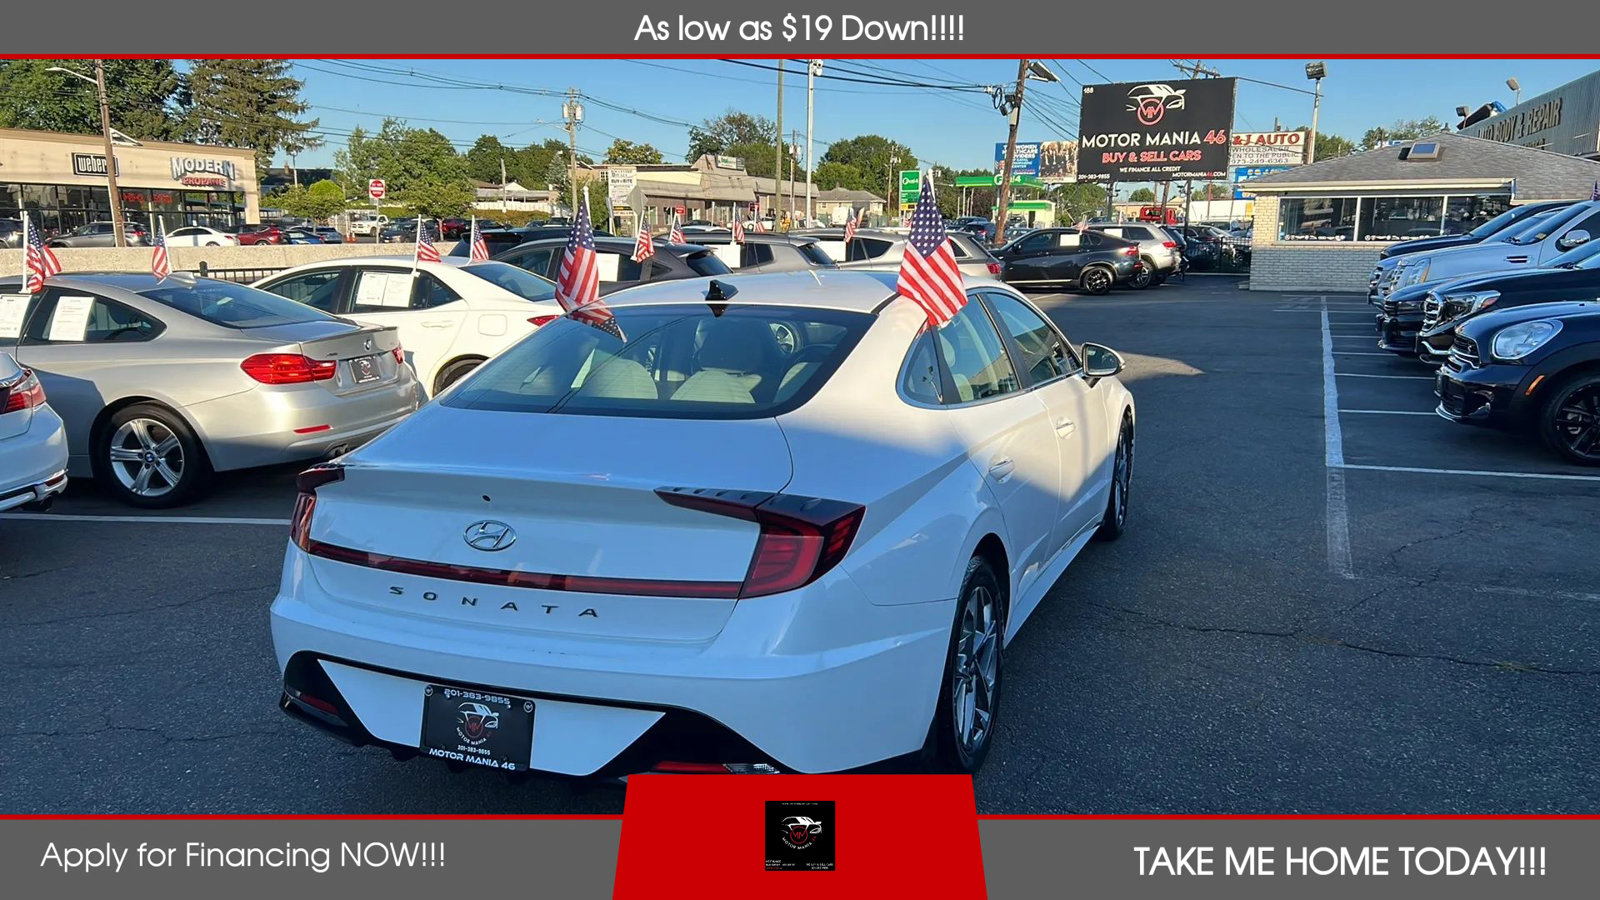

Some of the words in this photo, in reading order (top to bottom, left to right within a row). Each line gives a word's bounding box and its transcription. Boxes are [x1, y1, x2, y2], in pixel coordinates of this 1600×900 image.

[1527, 98, 1563, 135] REPAIR
[1082, 133, 1141, 148] MOTOR
[1146, 131, 1201, 146] MANIA
[1203, 129, 1227, 145] 46
[1255, 133, 1300, 145] AUTO
[78, 155, 107, 172] weber
[1102, 152, 1127, 163] BUY
[1128, 152, 1138, 162] &
[1140, 151, 1168, 162] SELL
[1170, 149, 1202, 161] CARS
[170, 157, 236, 181] MODERN
[182, 177, 227, 187] PROPANE
[389, 586, 599, 618] SONATA
[444, 688, 511, 705] 201-383-9855
[429, 748, 464, 761] MOTOR
[465, 755, 499, 768] MANIA
[501, 761, 516, 770] 46
